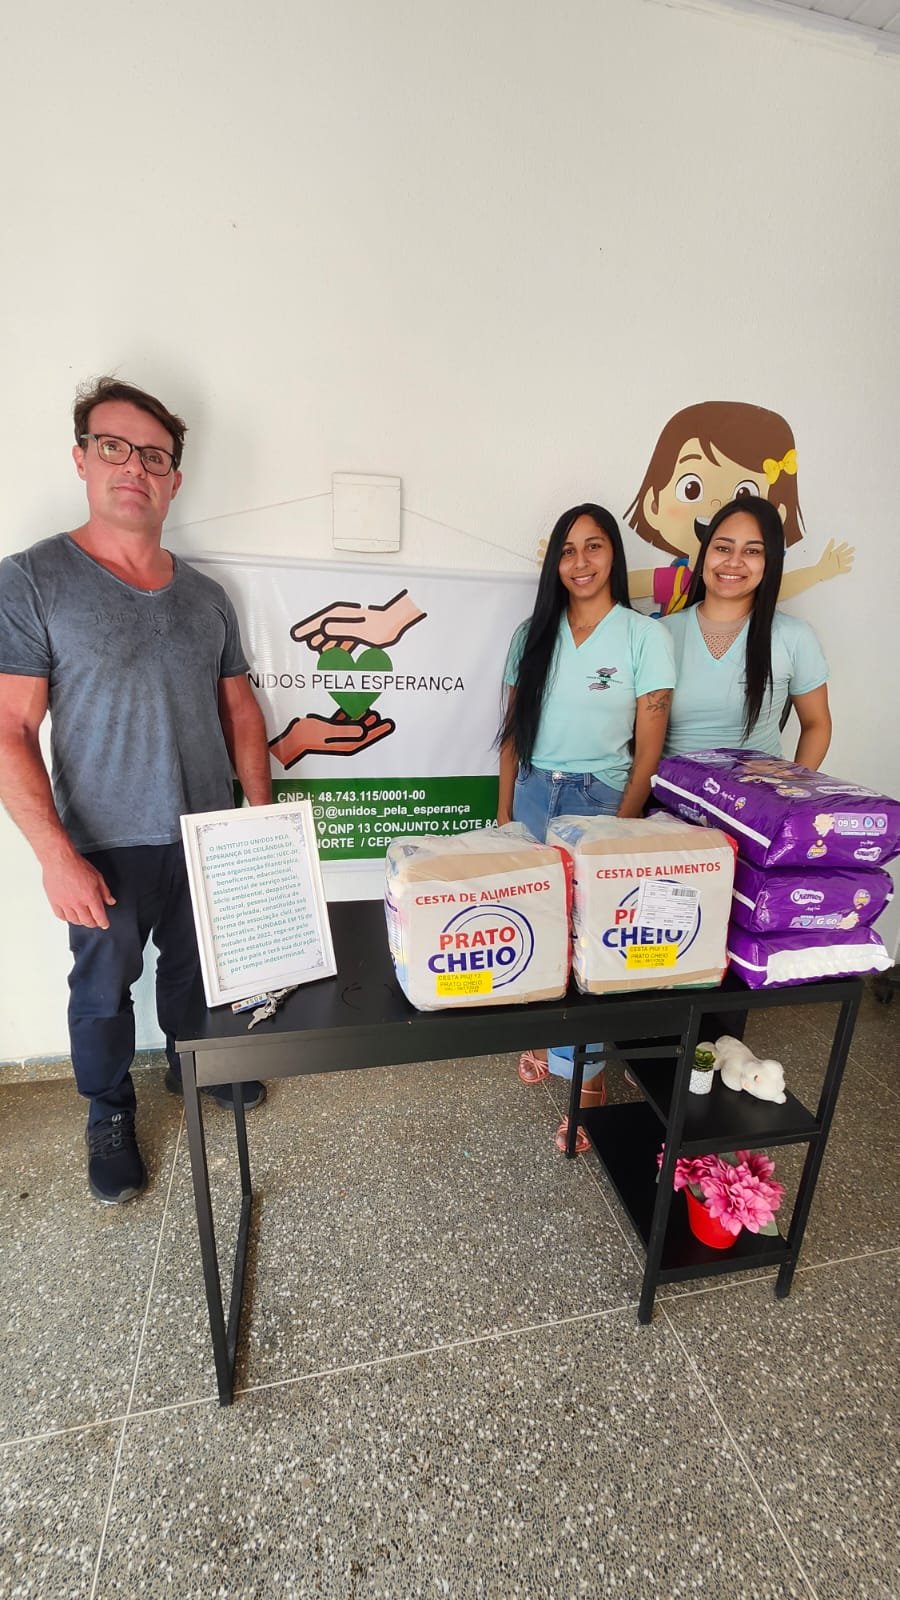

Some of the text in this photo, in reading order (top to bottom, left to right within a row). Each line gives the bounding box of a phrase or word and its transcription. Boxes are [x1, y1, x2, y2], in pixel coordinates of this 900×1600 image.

[247, 673, 465, 694] NIDOS PELA ESPERANÇA
[278, 790, 426, 802] CNPJ: 48.743.115/0001-00
[326, 804, 470, 818] @unidos_pela_esperança
[328, 824, 354, 834] QNP
[358, 823, 371, 833] 13
[374, 821, 439, 832] CONJUNTO
[442, 820, 450, 830] X
[452, 819, 482, 830] LOTE
[596, 861, 721, 879] CESTA DE ALIMENTOS
[415, 880, 550, 906] CESTA DE ALIMENTOS
[439, 926, 516, 950] PRATO
[428, 946, 516, 974] CHEIO
